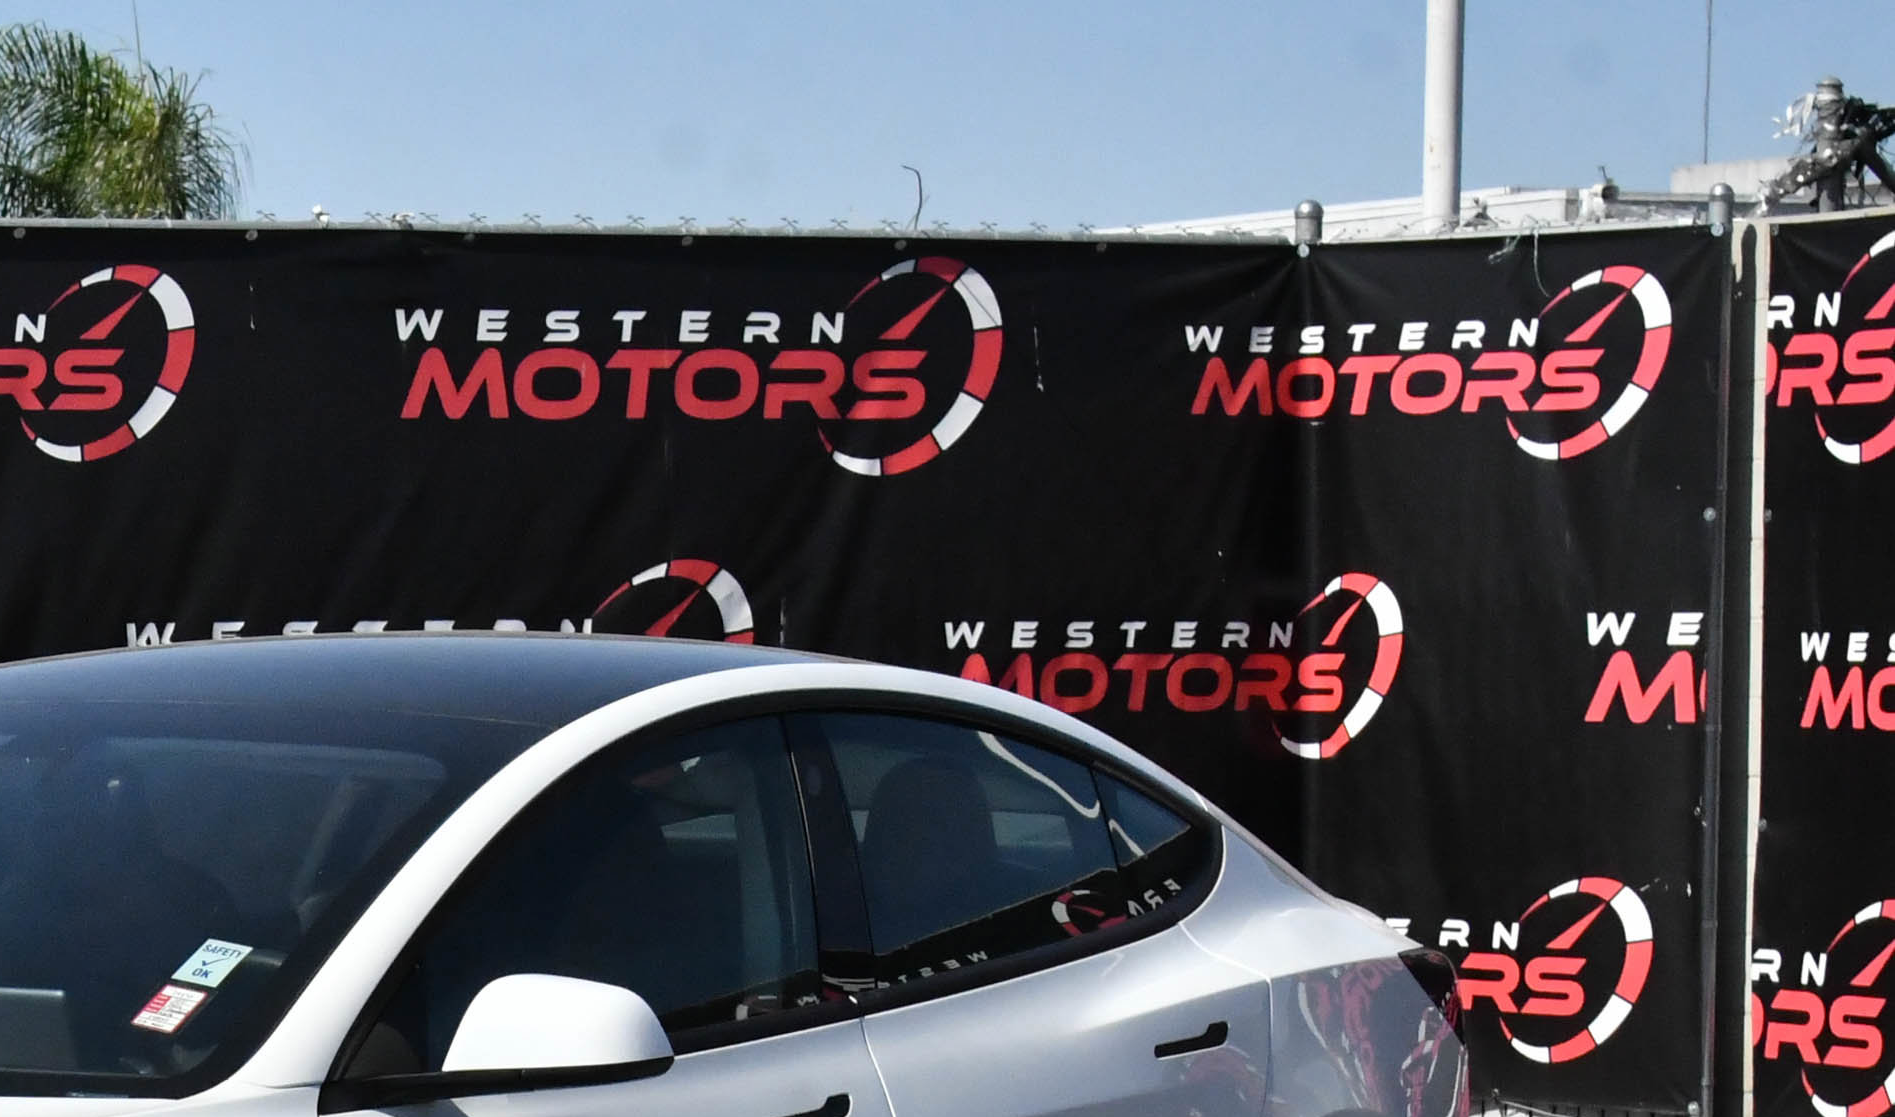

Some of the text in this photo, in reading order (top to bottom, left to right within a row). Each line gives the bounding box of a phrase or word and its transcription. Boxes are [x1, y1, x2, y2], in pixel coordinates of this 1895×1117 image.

[395, 308, 845, 344] WESTERN
[1184, 317, 1540, 355] WESTERN
[400, 345, 928, 421] MOTORS
[1191, 347, 1606, 419] MOTORS
[944, 621, 1293, 650] WESTERN
[202, 943, 244, 959] SAFETY
[191, 967, 214, 979] OK
